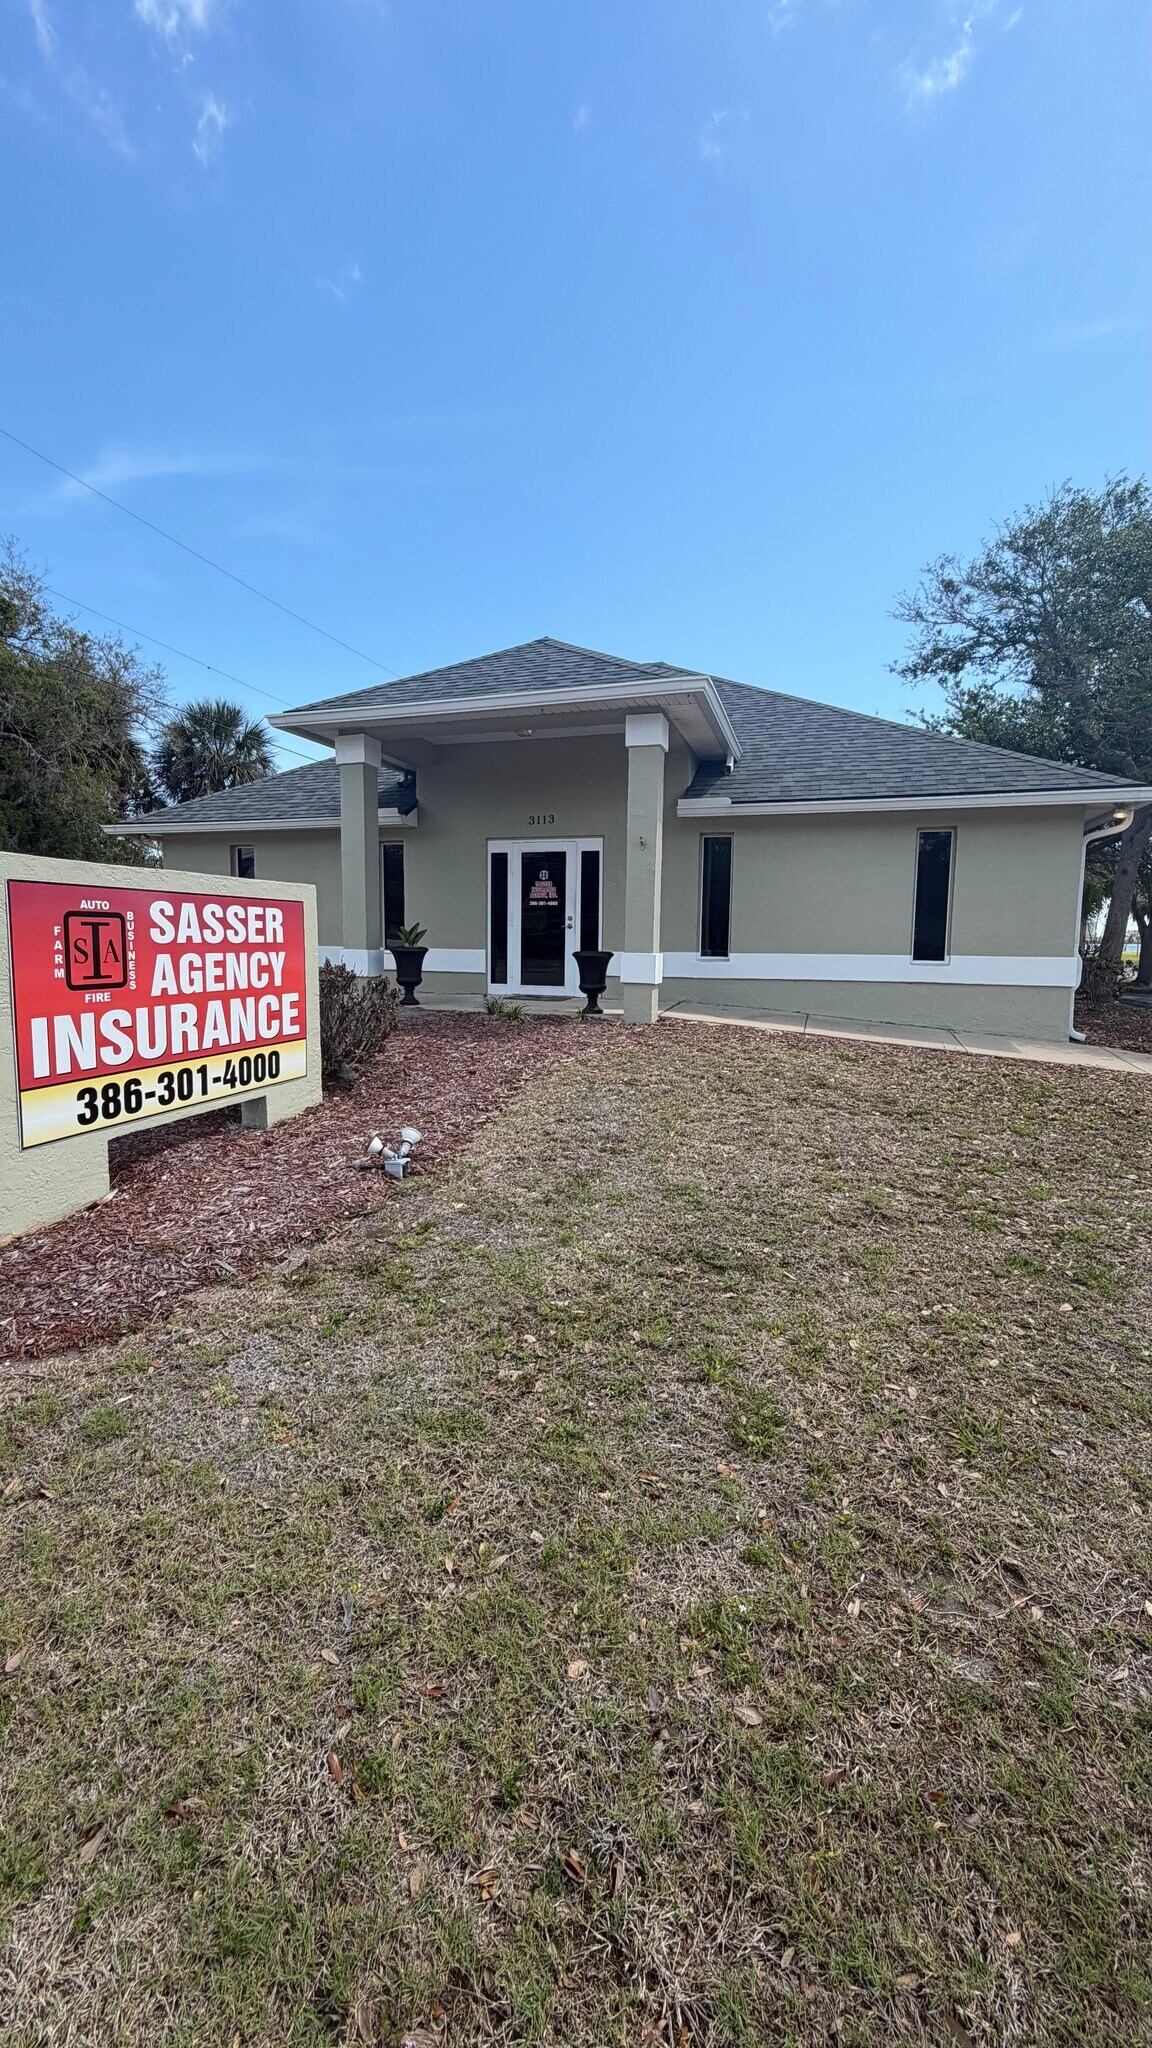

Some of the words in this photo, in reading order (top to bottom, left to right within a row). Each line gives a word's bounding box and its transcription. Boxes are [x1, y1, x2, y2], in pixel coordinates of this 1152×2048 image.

[528, 814, 555, 825] 3113
[80, 900, 110, 910] AUTO
[149, 900, 285, 944] SASSER
[54, 926, 65, 978] FARM
[126, 911, 137, 990] BUSINESS
[150, 951, 286, 997] AGENCY
[85, 992, 112, 1003] FIRE
[31, 992, 301, 1079] INSURANCE
[76, 1050, 281, 1126] 386-301-4000
